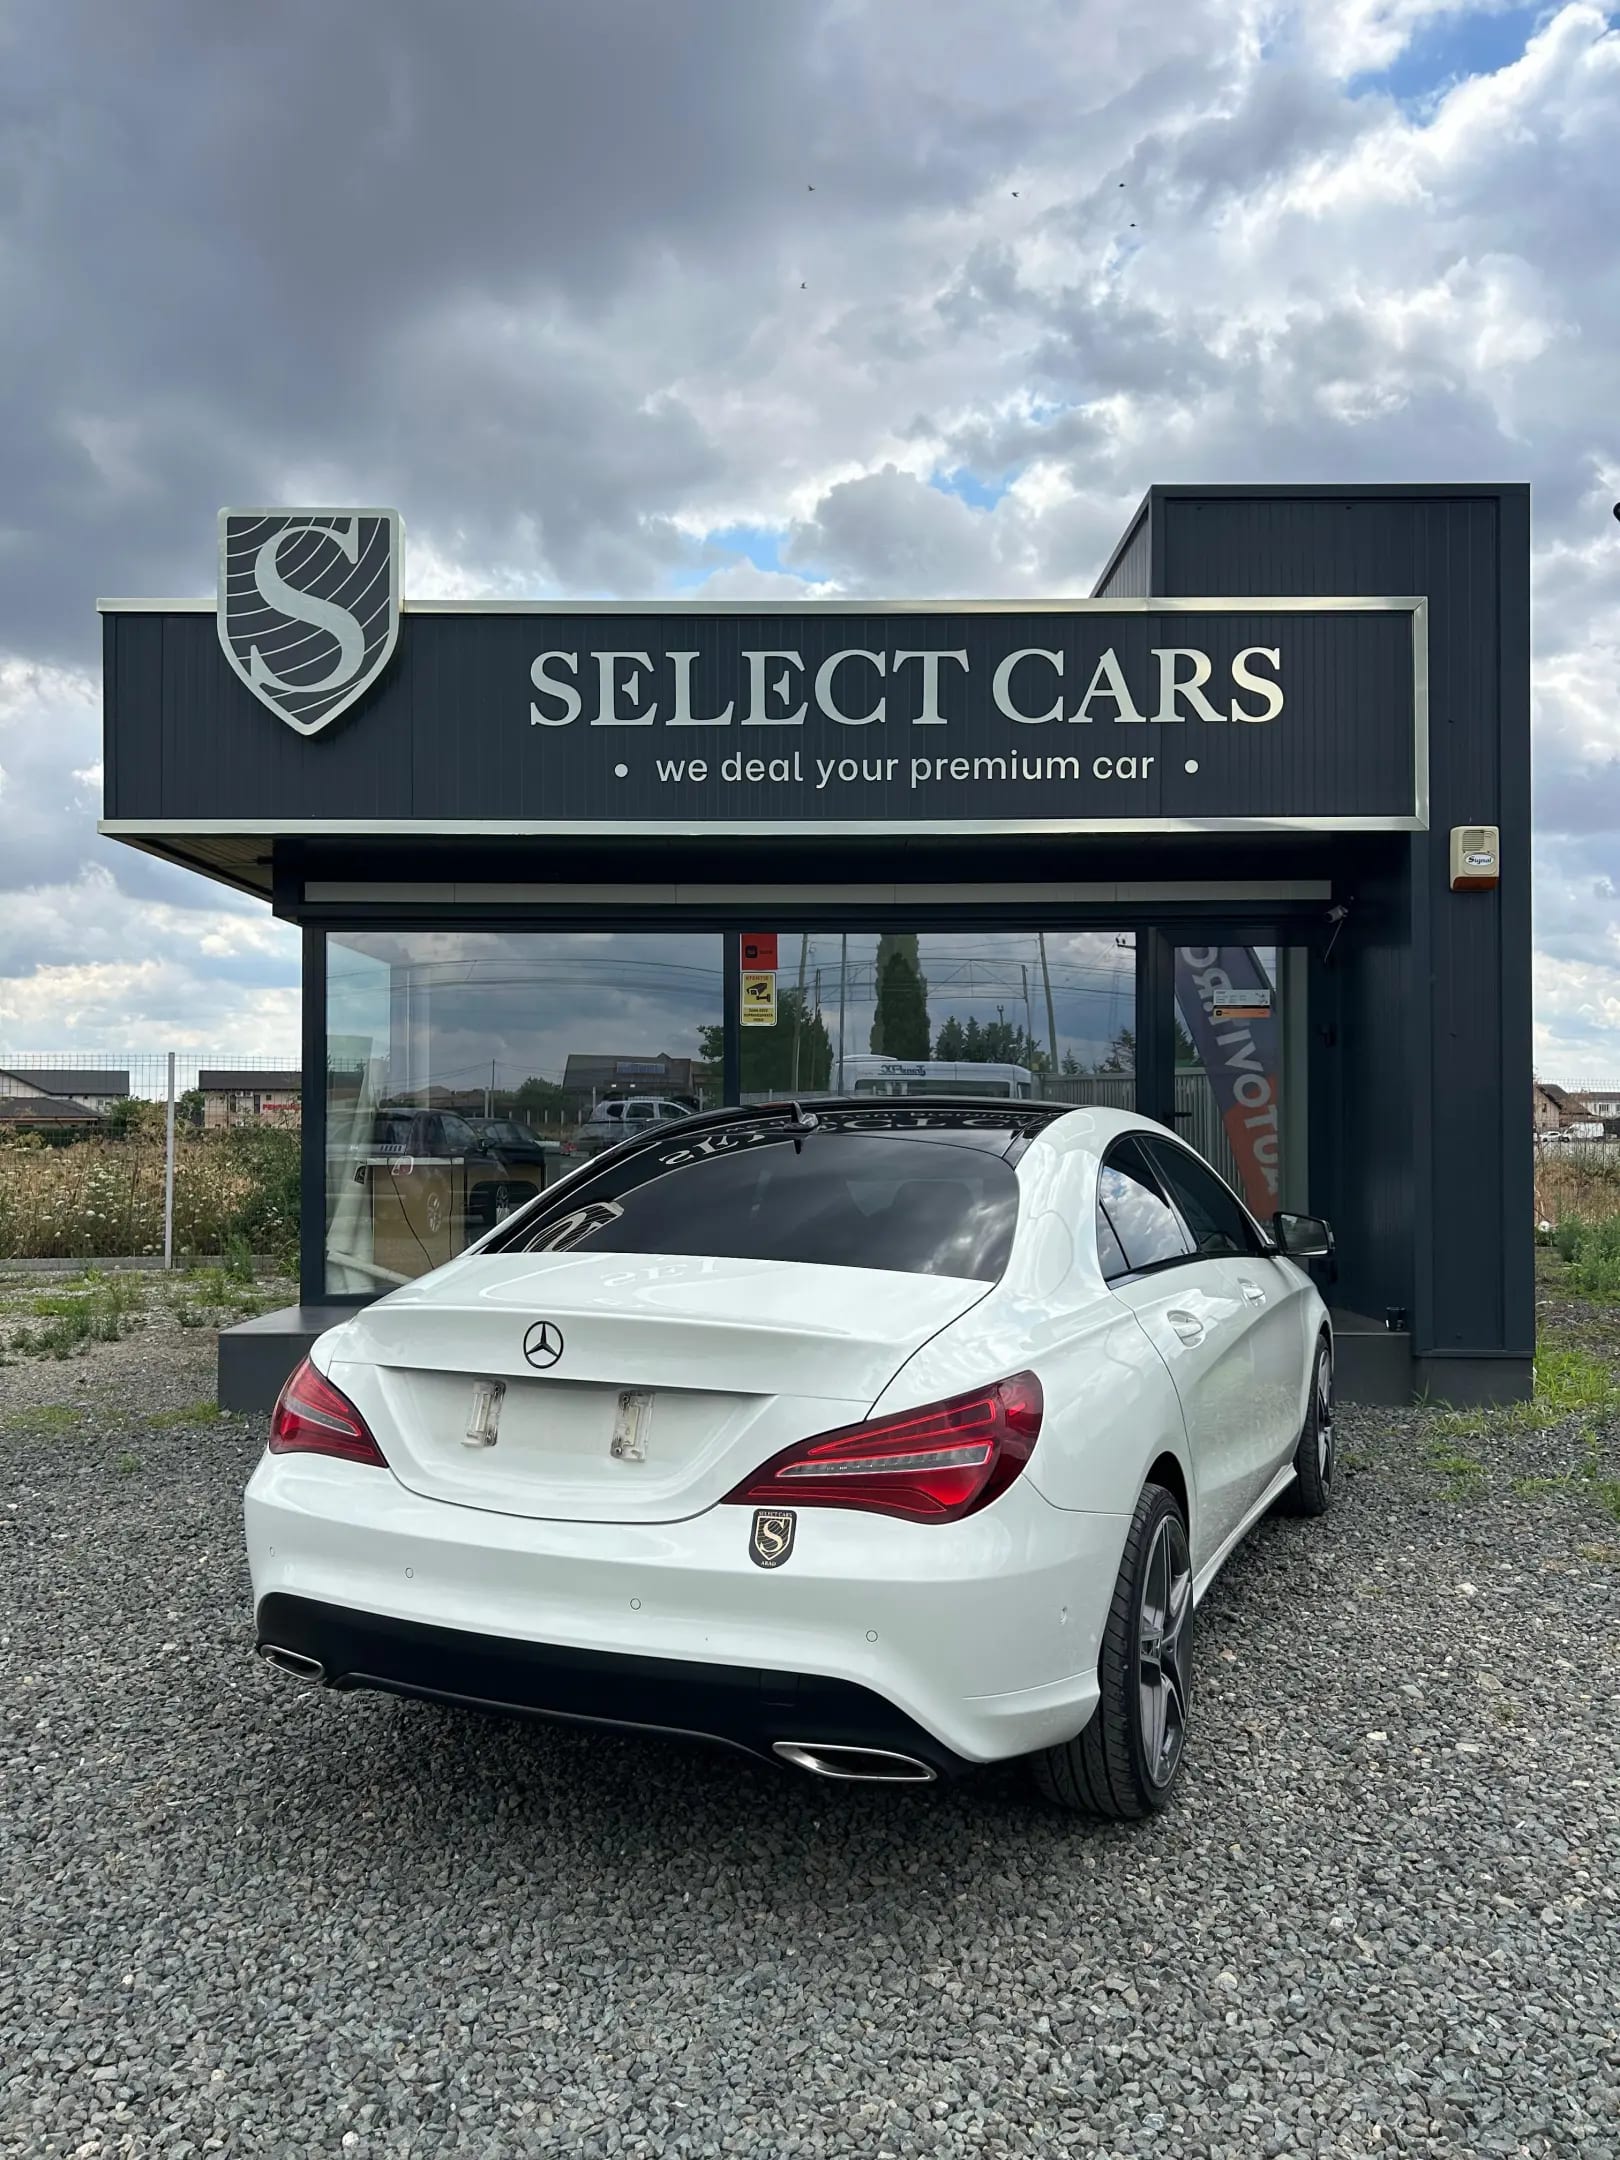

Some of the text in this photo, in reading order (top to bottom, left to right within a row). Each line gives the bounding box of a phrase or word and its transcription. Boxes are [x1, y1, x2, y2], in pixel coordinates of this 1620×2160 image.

[531, 647, 1283, 725] SELECT CARS
[656, 750, 1154, 788] we deal your premium car
